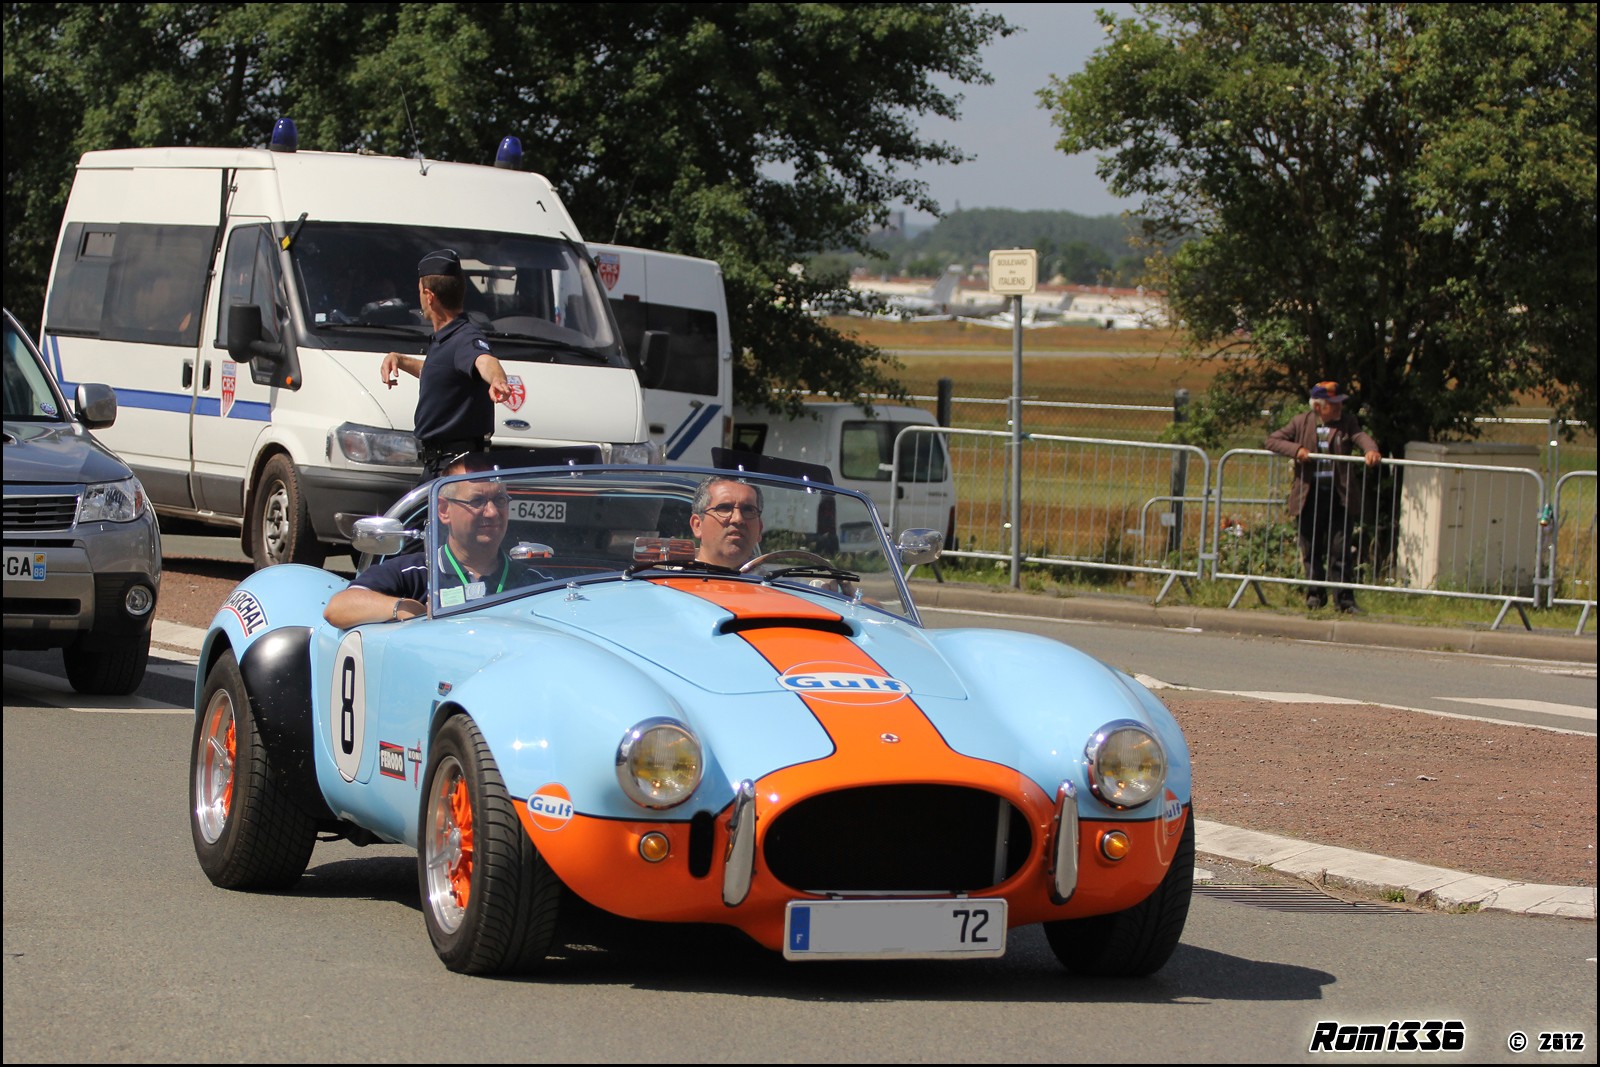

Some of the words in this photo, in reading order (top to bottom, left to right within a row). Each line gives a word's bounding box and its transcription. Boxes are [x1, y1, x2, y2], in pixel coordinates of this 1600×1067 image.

[600, 263, 618, 274] CRS
[998, 277, 1026, 286] ITALIENS
[223, 377, 235, 391] CRS
[34, 567, 44, 578] 88
[784, 675, 902, 691] Gulf
[341, 655, 355, 755] 8
[380, 749, 404, 772] FERODO
[529, 796, 572, 817] Gulf
[796, 933, 803, 944] F
[952, 909, 989, 943] 72
